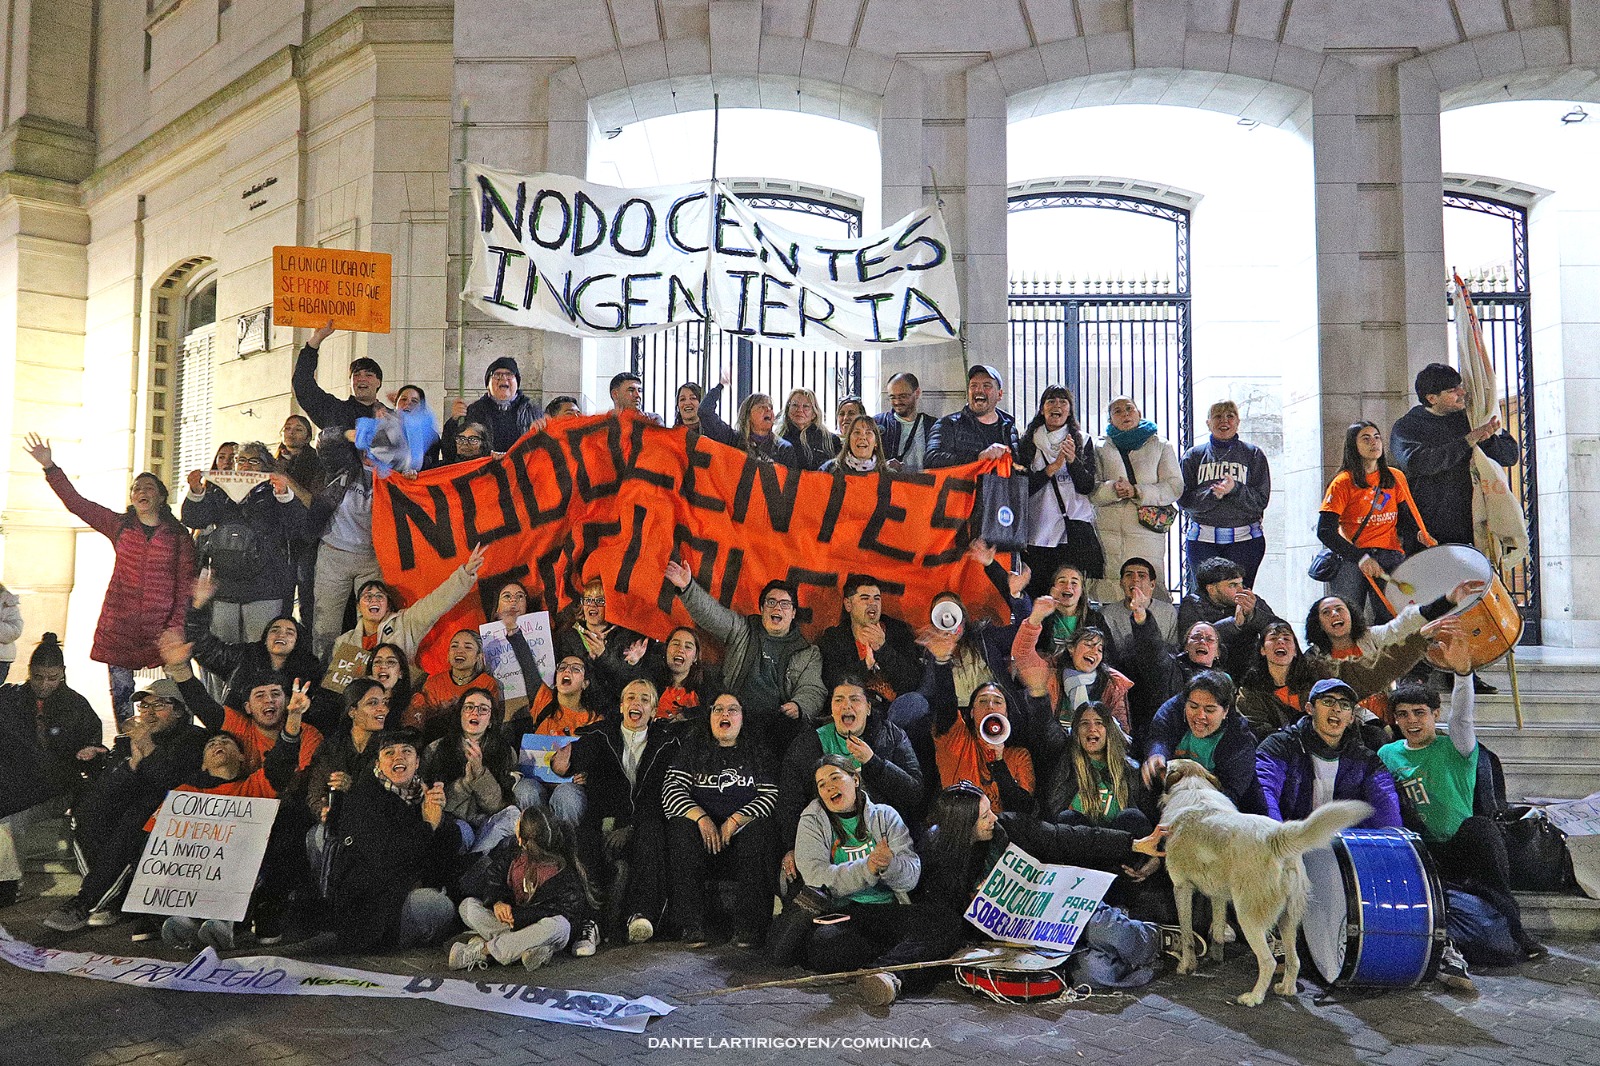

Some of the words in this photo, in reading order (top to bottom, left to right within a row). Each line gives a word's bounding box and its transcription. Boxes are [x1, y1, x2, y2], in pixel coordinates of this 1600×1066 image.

[280, 254, 296, 271] LA
[331, 259, 358, 277] LUCHA
[359, 262, 376, 278] QUE
[281, 276, 294, 293] SE
[297, 278, 330, 295] PIERDE
[337, 280, 351, 296] ES
[352, 282, 364, 298] LA
[365, 285, 380, 300] QUE
[482, 245, 961, 343] INGENIERIA
[282, 296, 295, 312] SE
[298, 297, 356, 316] ABANDONA
[1197, 461, 1248, 485] UNICEN
[338, 659, 355, 672] DE
[171, 794, 252, 818] CONCEJALA
[150, 837, 168, 856] LA
[213, 846, 224, 860] A
[142, 858, 202, 880] CONOCER
[206, 866, 222, 881] LA
[1070, 877, 1085, 890] Y
[143, 888, 198, 908] UNICEN
[1062, 896, 1097, 913] PARA
[1061, 909, 1079, 925] LA
[1028, 920, 1079, 946] NACIONAL
